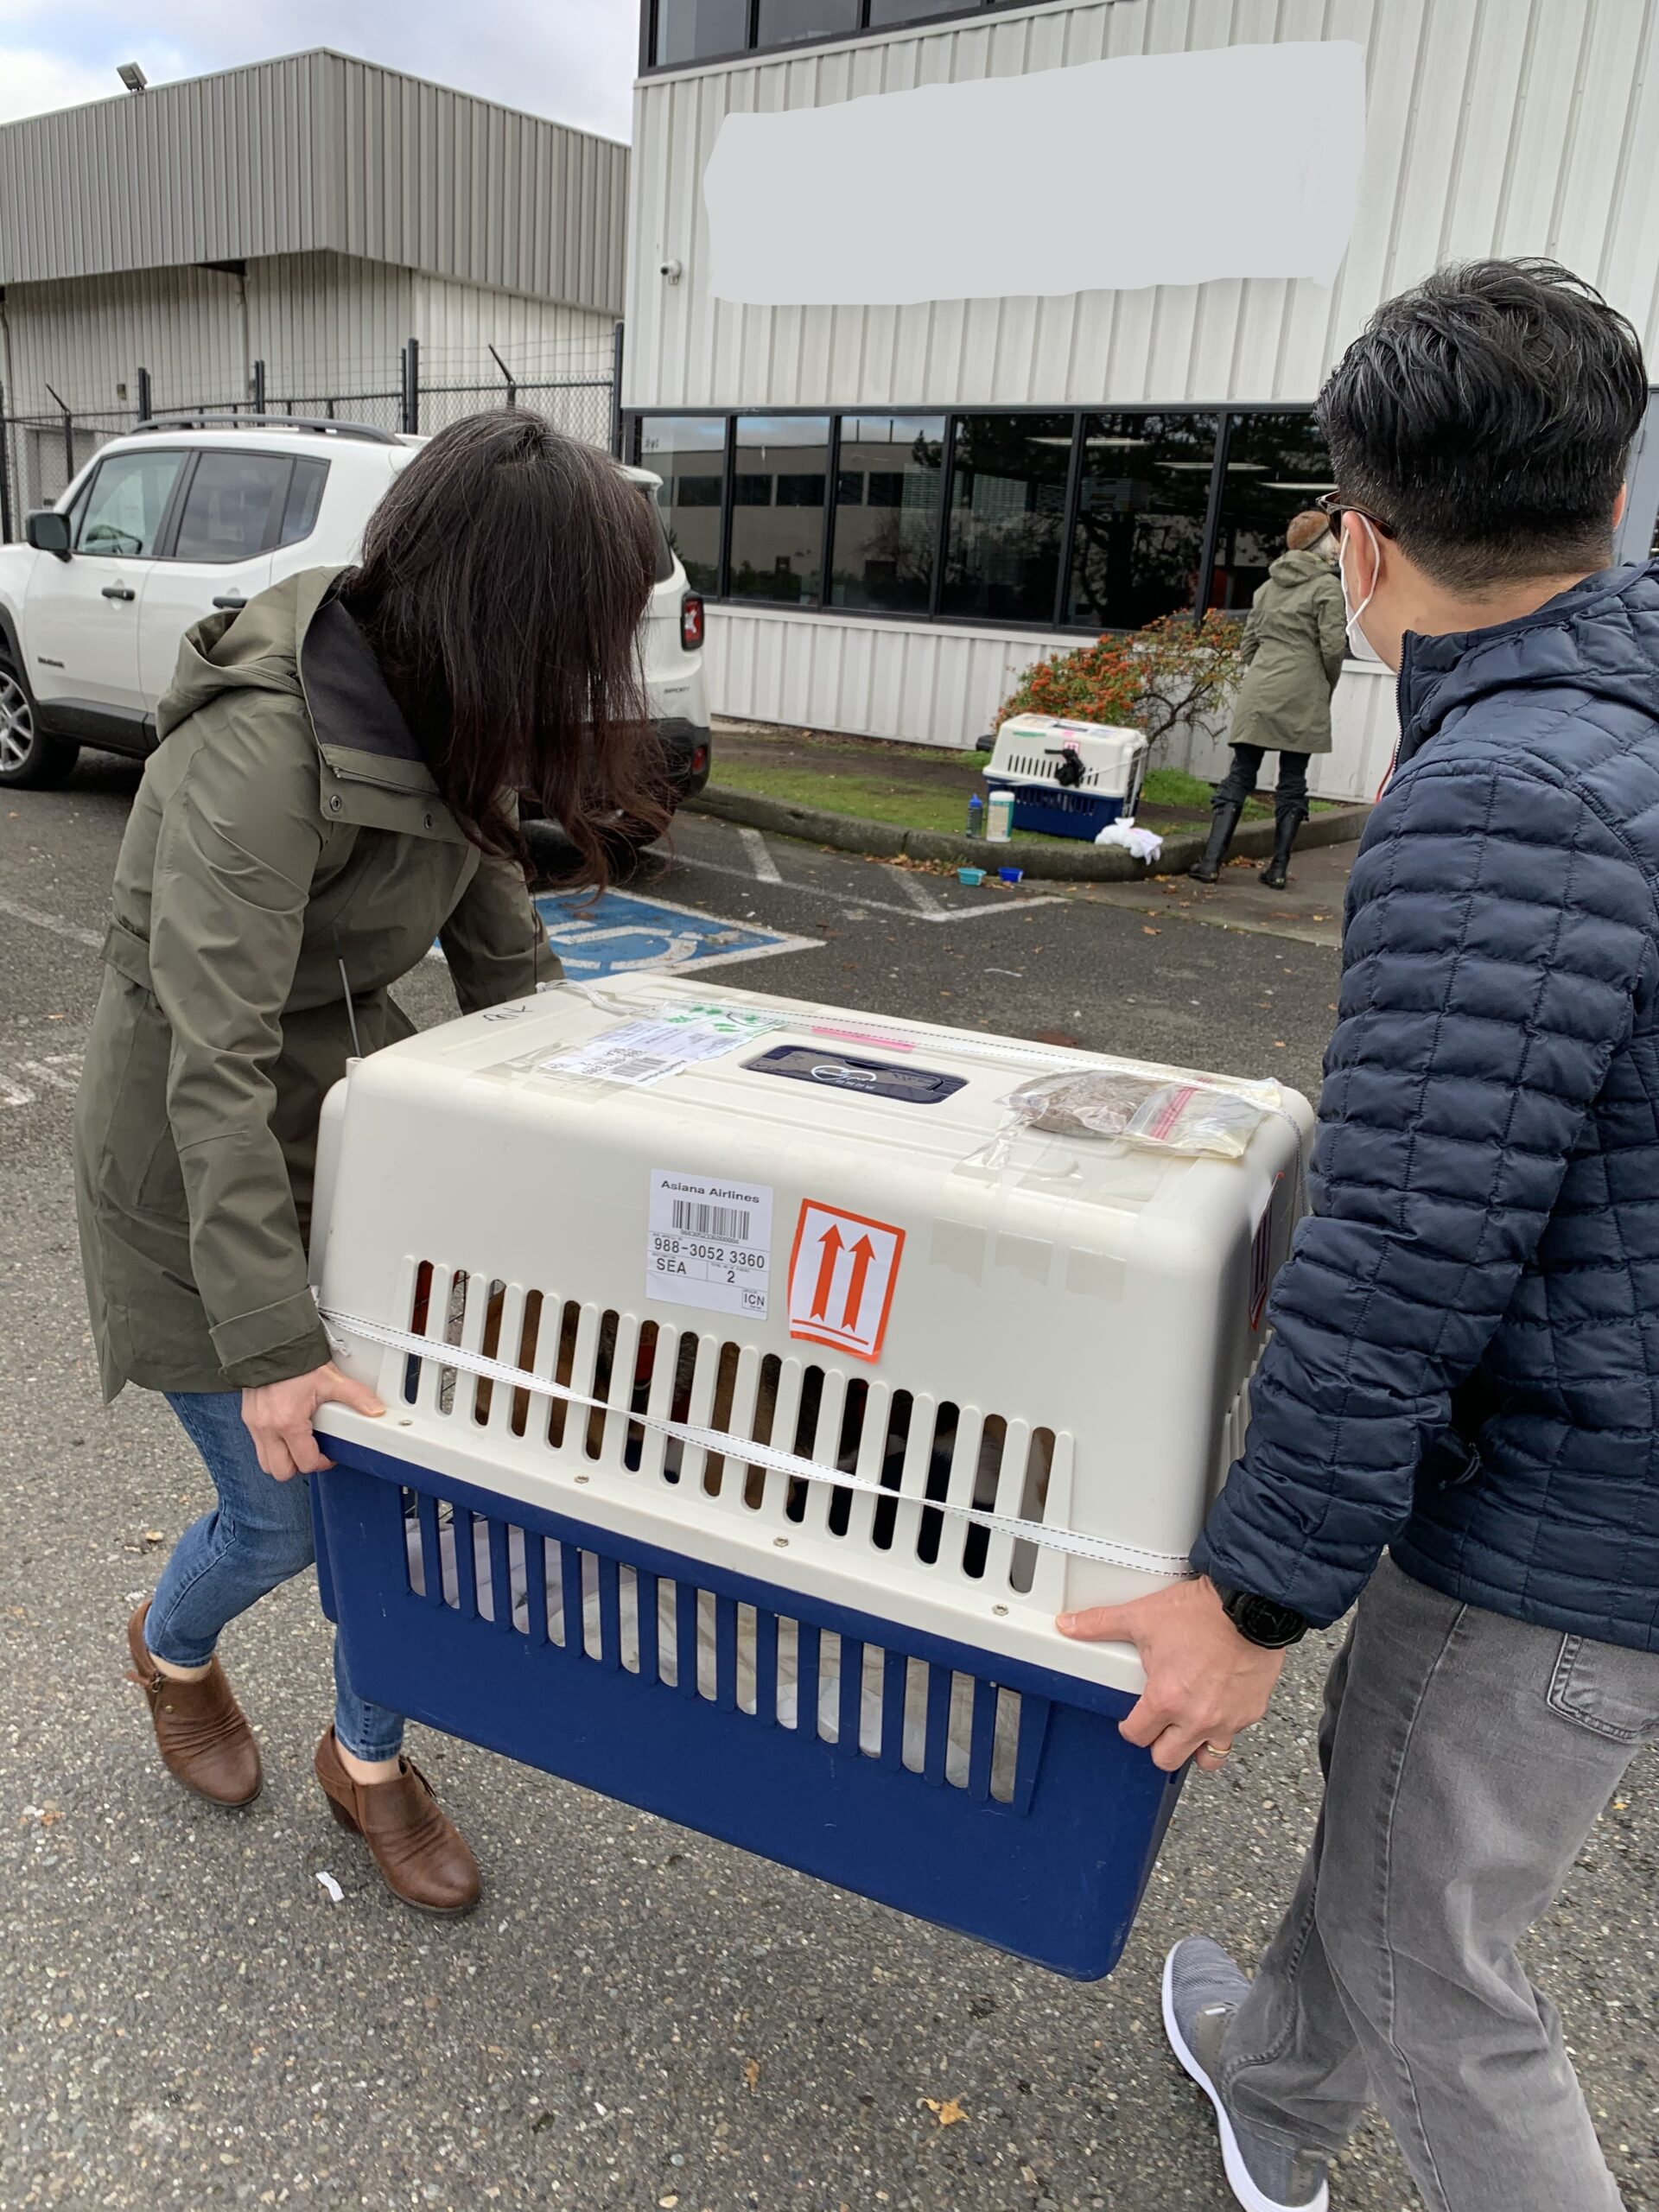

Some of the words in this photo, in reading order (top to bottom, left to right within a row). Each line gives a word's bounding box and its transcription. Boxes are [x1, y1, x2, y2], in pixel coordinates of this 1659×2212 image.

[661, 1180, 705, 1194] Asiana
[709, 1188, 760, 1203] Airlines
[654, 1238, 724, 1262] 988-3052
[729, 1250, 765, 1268] 3360
[657, 1258, 686, 1274] SEA
[727, 1270, 735, 1283] 2
[744, 1294, 765, 1306] ICN
